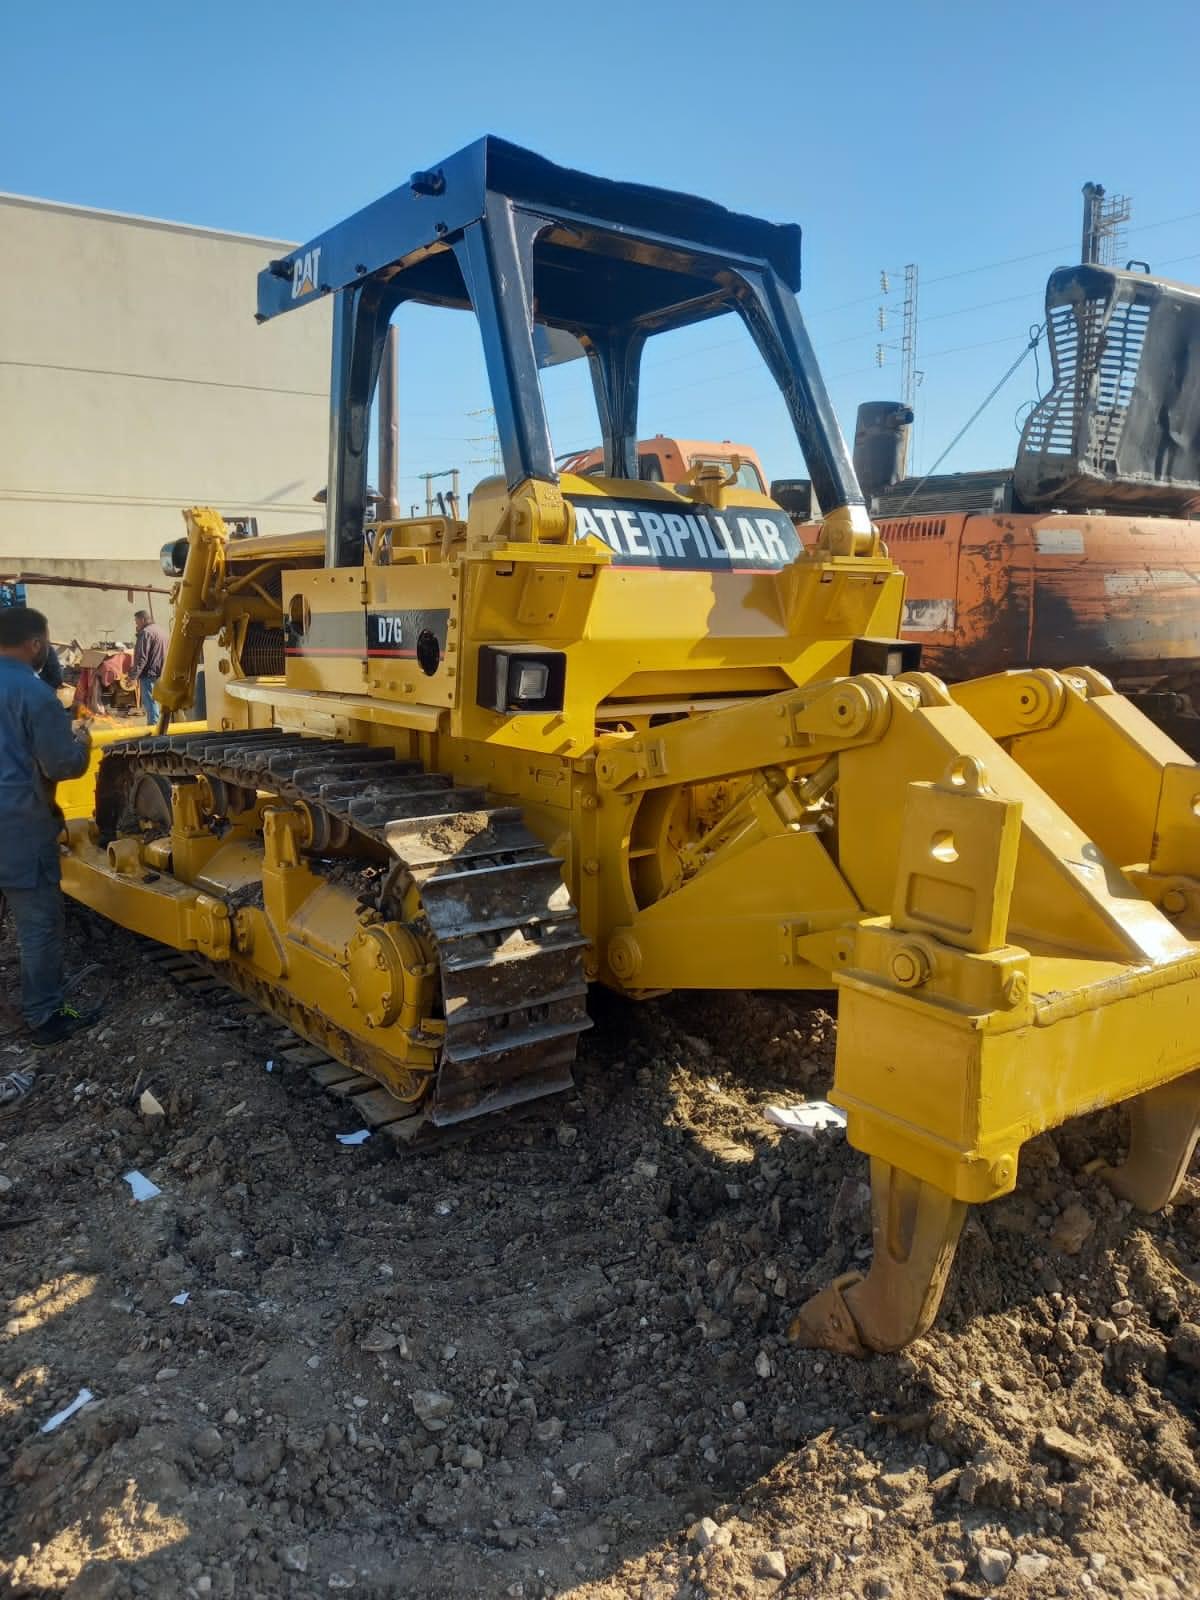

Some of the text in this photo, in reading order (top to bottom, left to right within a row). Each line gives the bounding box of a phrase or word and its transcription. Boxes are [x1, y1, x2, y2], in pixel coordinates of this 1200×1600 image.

[291, 247, 321, 299] CAT
[574, 507, 790, 561] ATERPILLAR
[378, 617, 402, 643] D7G
